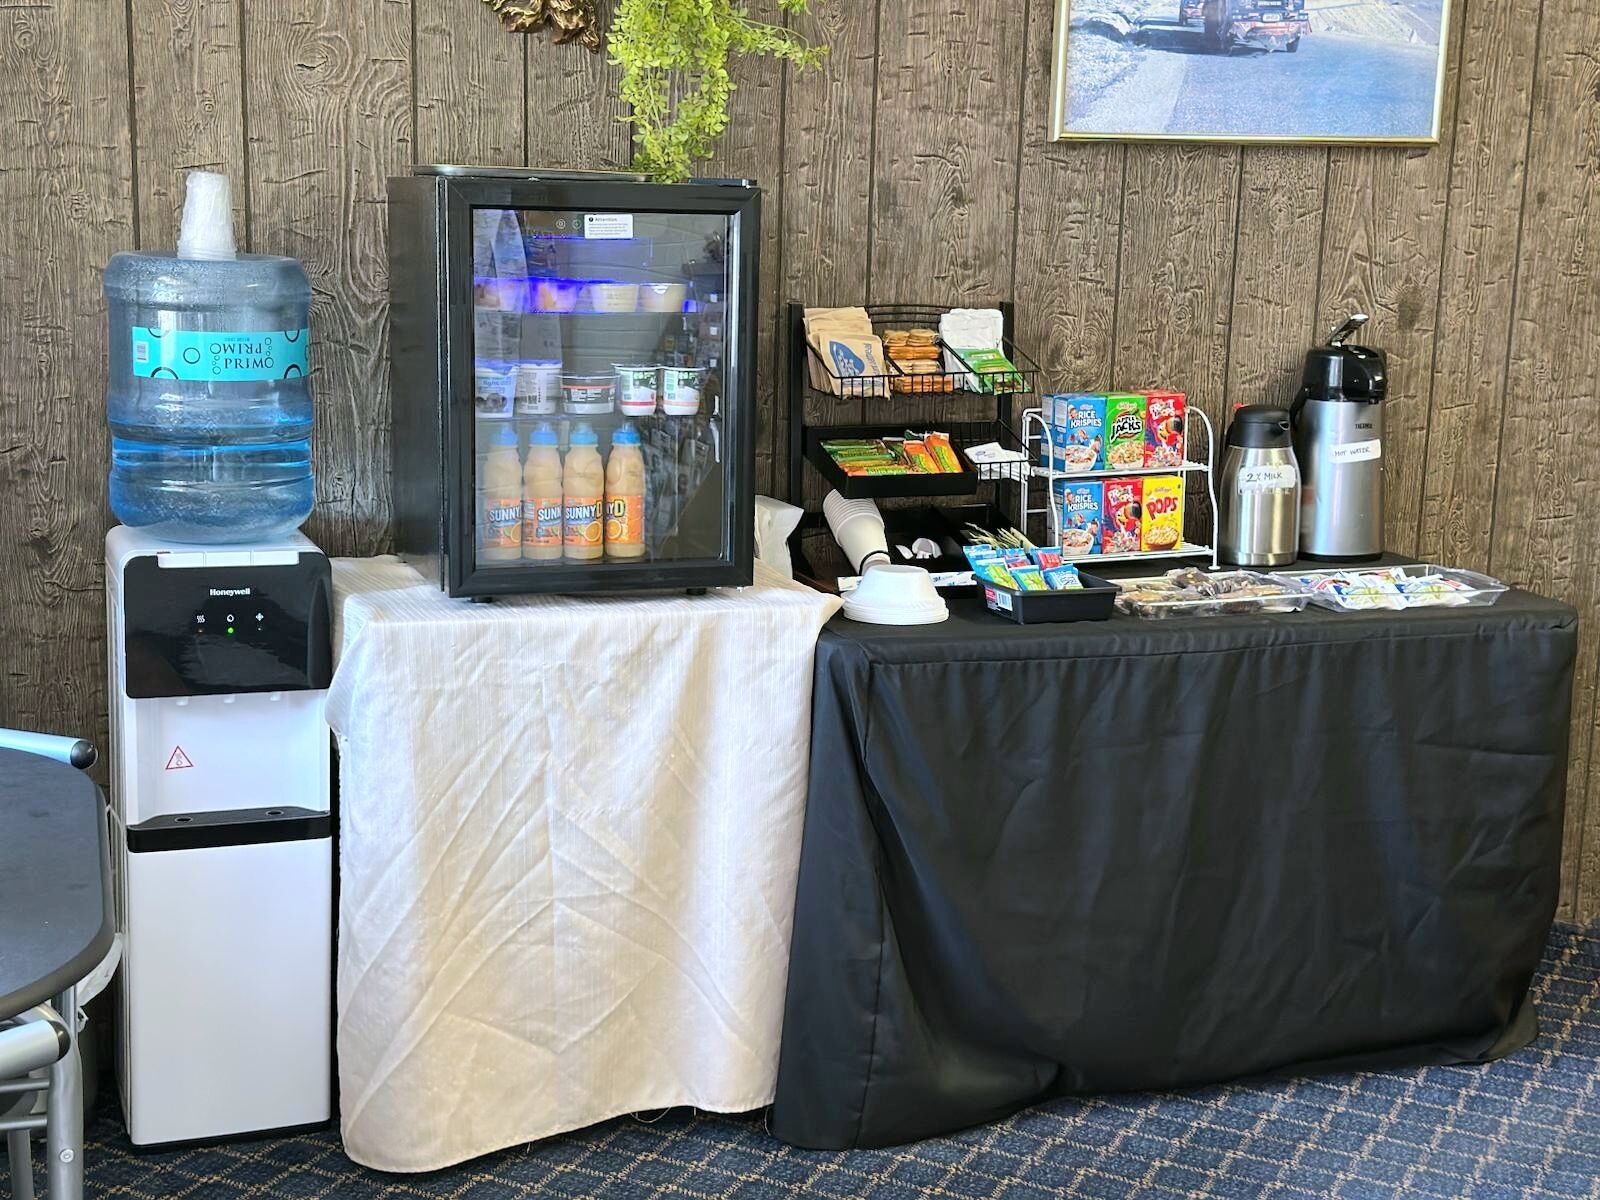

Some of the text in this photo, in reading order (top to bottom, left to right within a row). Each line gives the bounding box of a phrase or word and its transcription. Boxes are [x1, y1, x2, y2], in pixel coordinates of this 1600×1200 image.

[210, 343, 262, 354] PRIMO
[224, 357, 274, 369] PRIMO
[1078, 410, 1096, 419] RICE
[1071, 418, 1102, 429] KRISPIES
[1111, 420, 1141, 440] JACKS
[1349, 446, 1370, 455] WATER
[1264, 472, 1282, 481] MILK
[1075, 495, 1092, 503] RICE
[1068, 502, 1099, 513] KRISPIES
[1146, 496, 1178, 520] POPS
[210, 588, 250, 596] Honeywell
